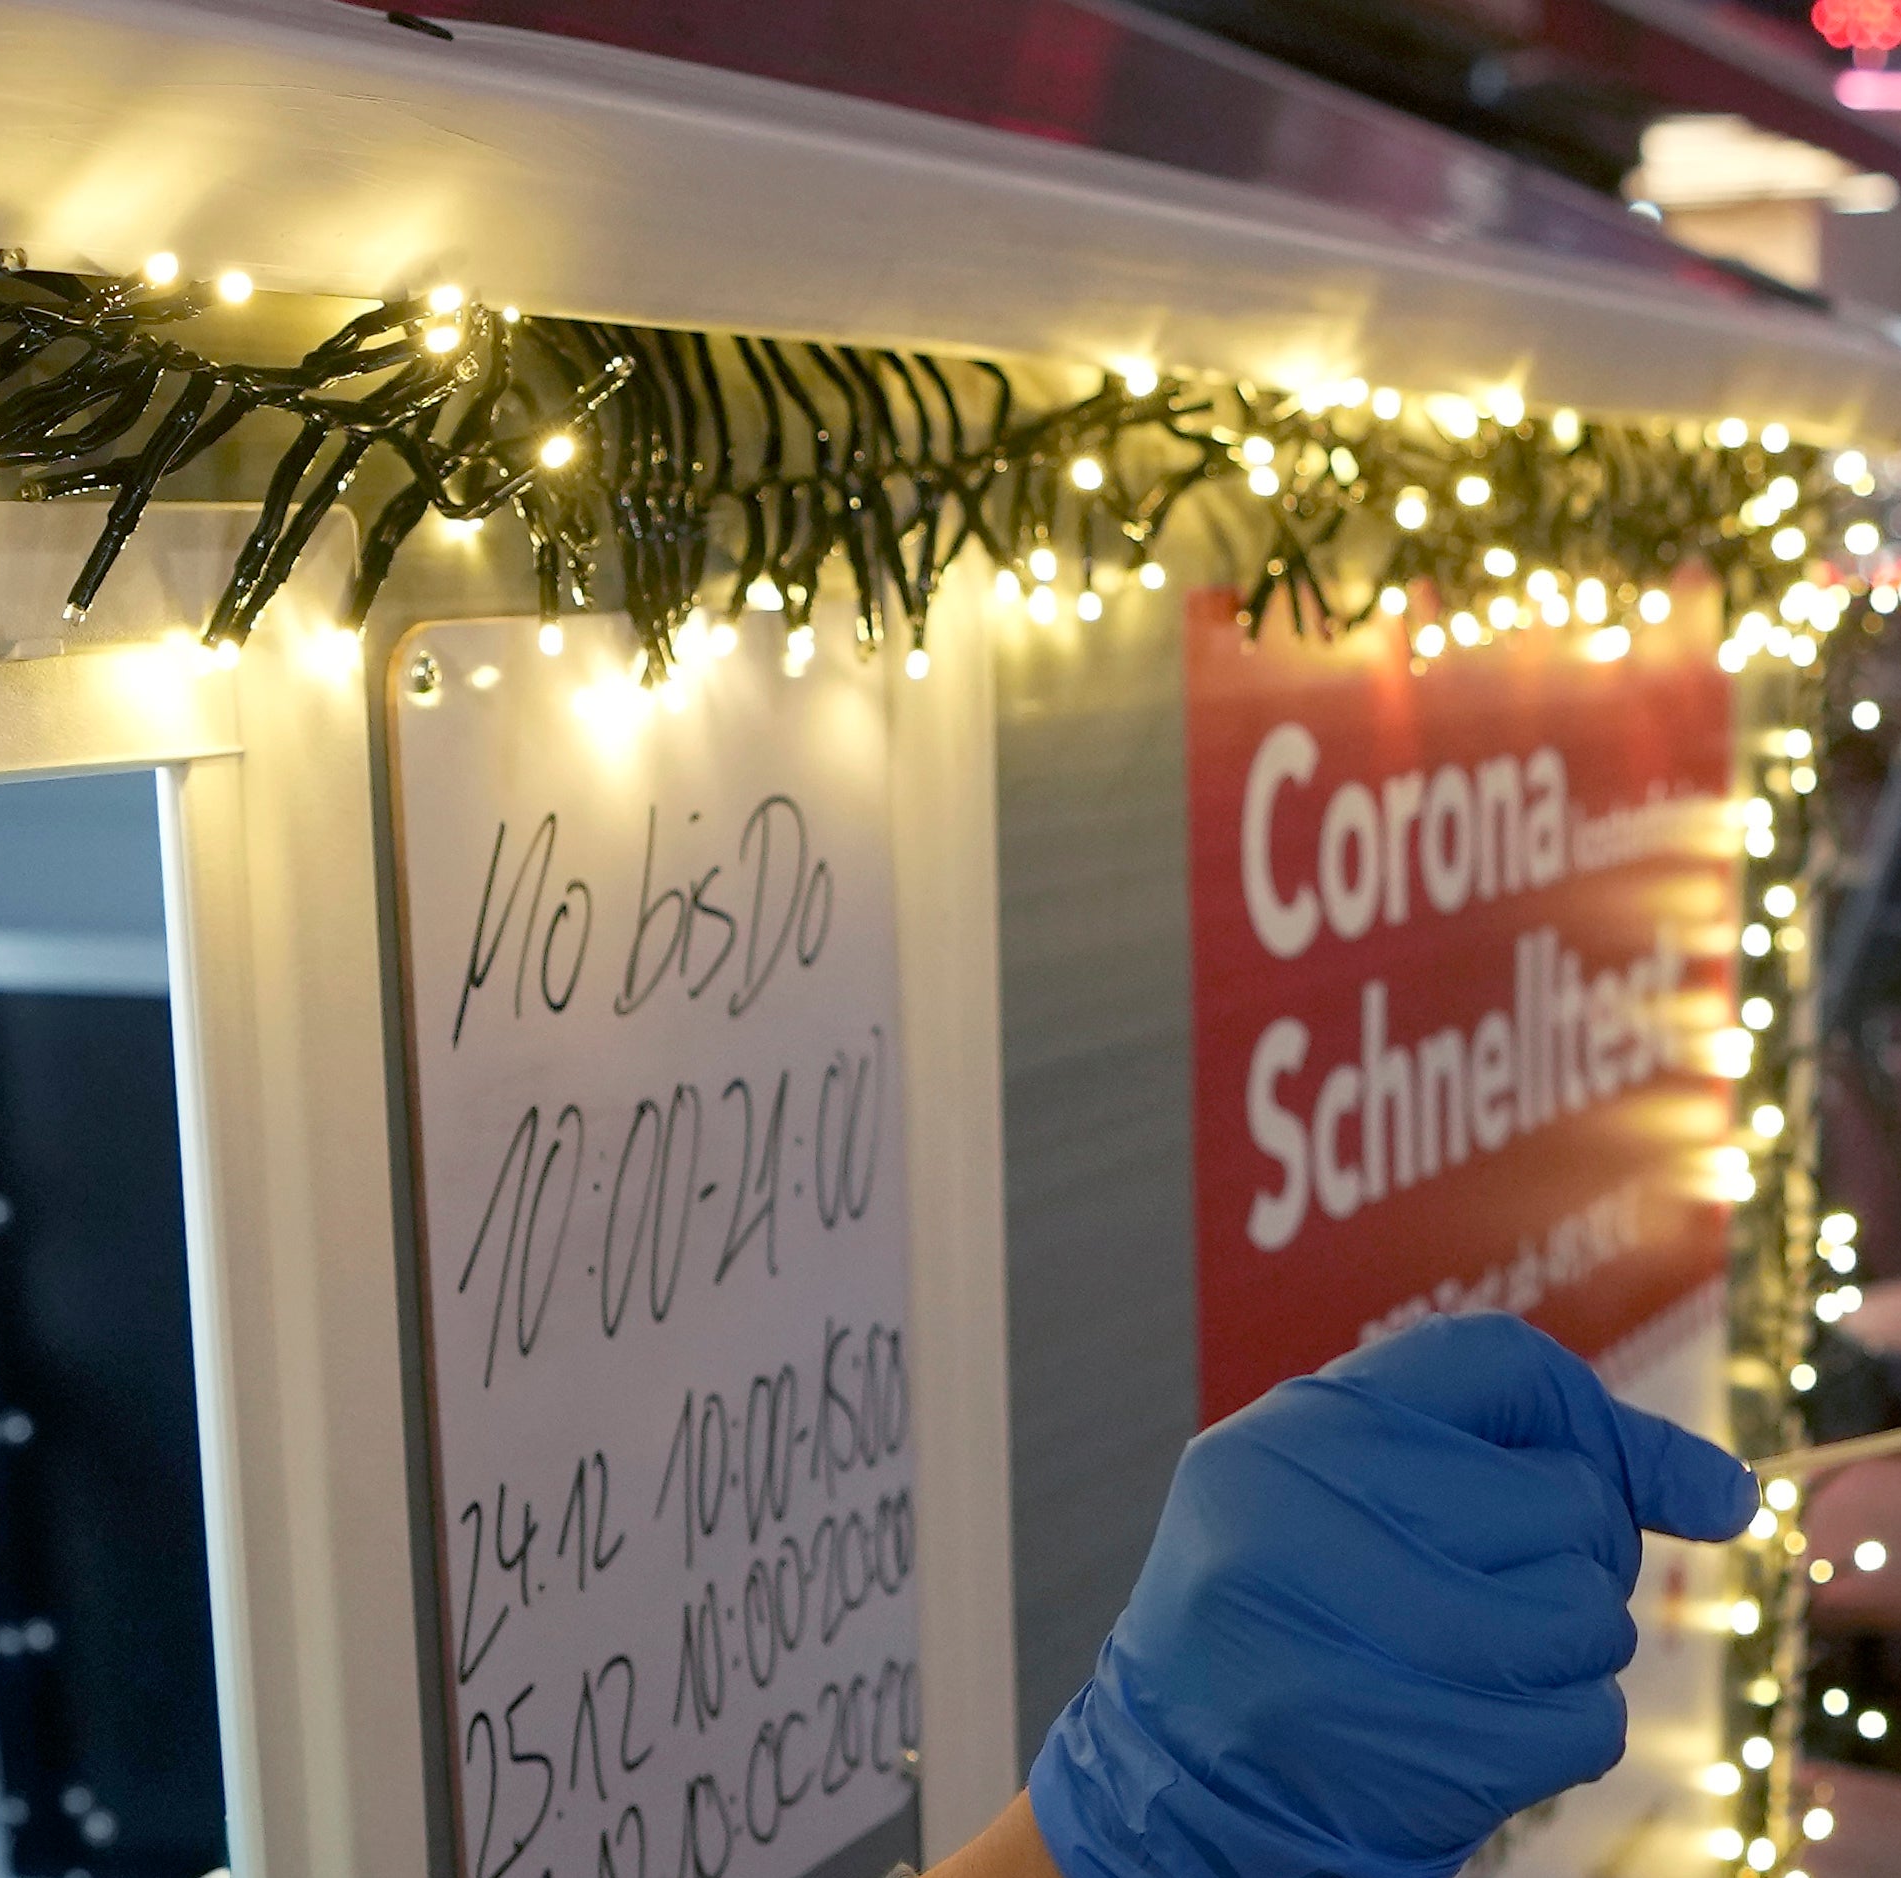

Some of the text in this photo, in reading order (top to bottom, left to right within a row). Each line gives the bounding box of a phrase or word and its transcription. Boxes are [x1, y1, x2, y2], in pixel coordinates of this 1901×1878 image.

[453, 794, 834, 1051] Mo bis Do
[1240, 721, 1568, 960] Corona
[1245, 918, 1691, 1252] Schnelltest
